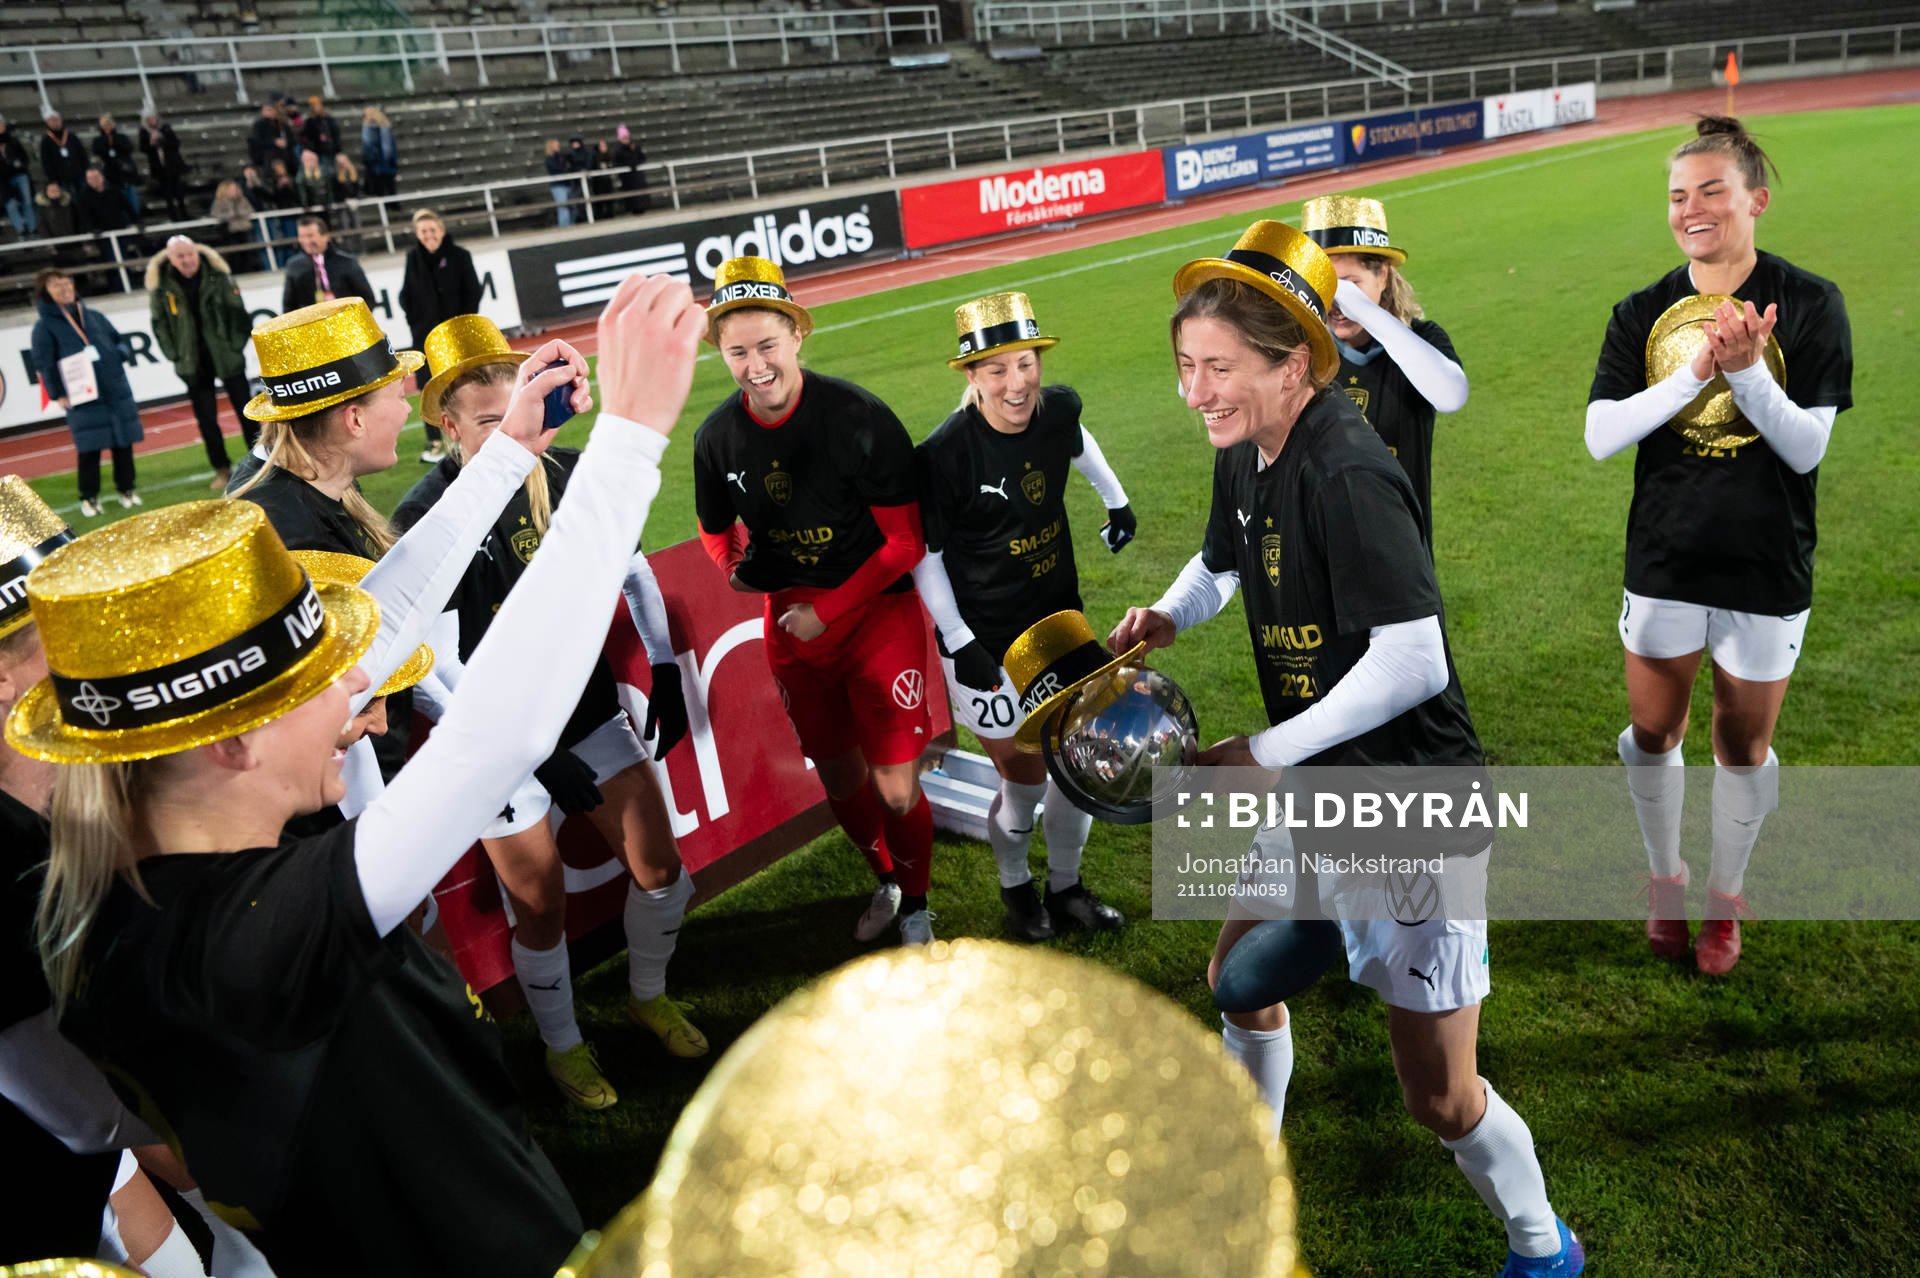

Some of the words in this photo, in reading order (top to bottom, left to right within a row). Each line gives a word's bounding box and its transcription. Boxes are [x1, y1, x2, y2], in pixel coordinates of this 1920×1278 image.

[1369, 119, 1433, 145] STOCKHOLMS
[1435, 112, 1478, 134] STOLTHET
[979, 168, 1105, 213] Moderna
[1006, 201, 1084, 226] Försäkringar
[695, 209, 874, 281] adidas
[518, 538, 539, 551] FCR
[1265, 548, 1281, 561] FCR
[1032, 553, 1057, 578] 202
[972, 694, 1015, 728] 20
